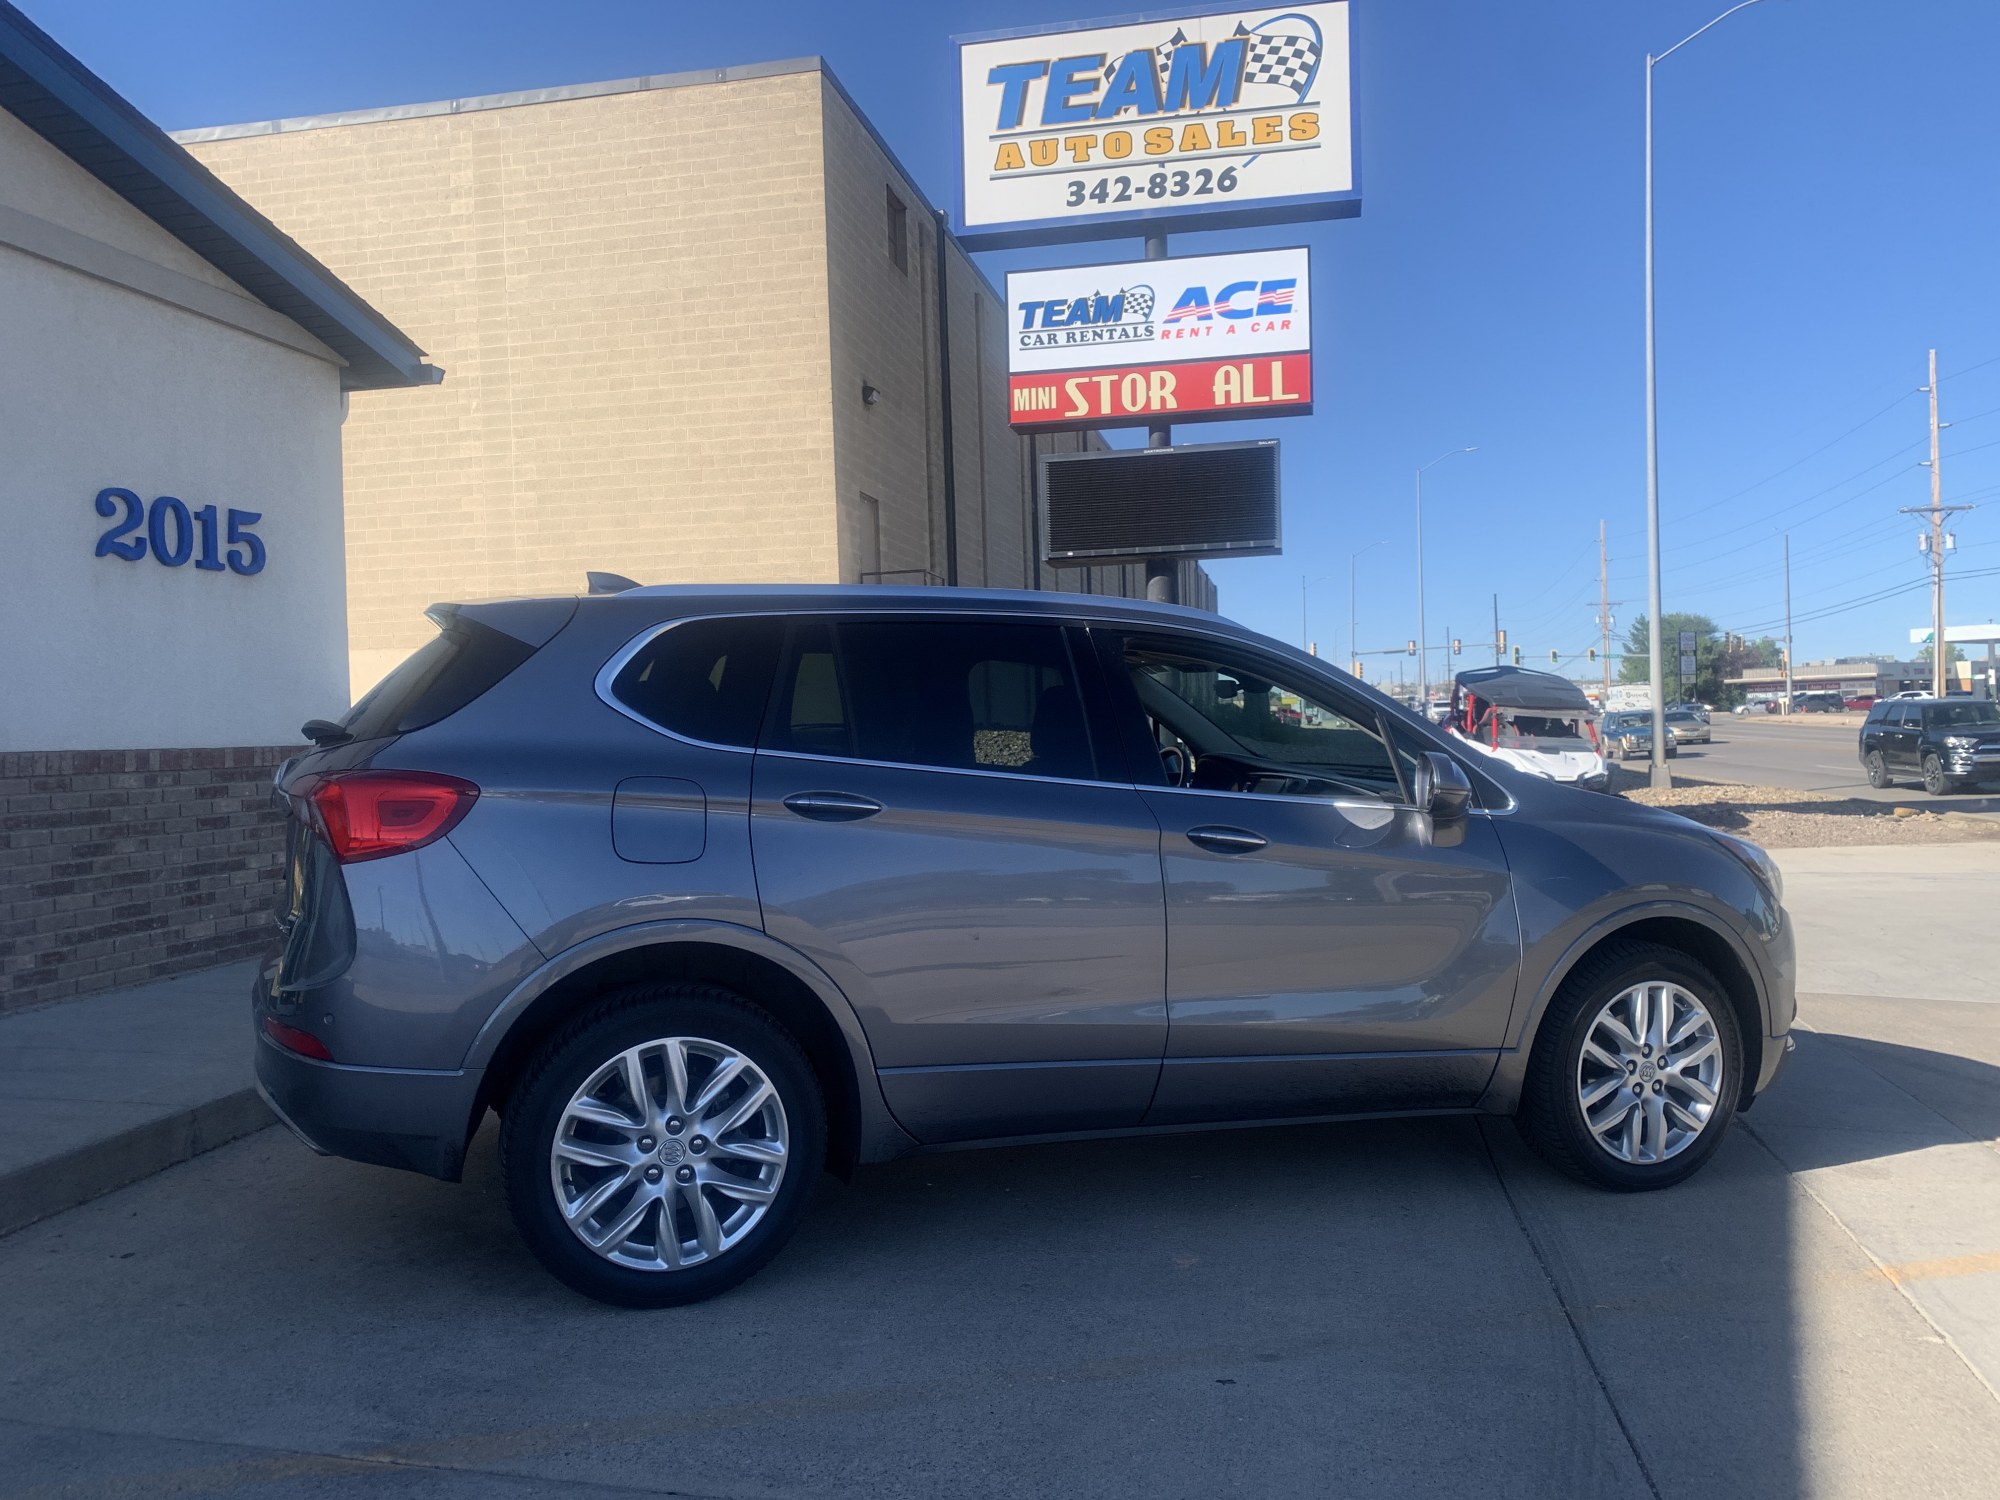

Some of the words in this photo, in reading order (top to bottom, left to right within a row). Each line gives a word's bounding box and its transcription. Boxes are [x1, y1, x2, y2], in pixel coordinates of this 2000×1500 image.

[986, 36, 1251, 131] TEAM
[994, 131, 1132, 170] AUTO
[1144, 112, 1320, 155] SALES
[1066, 166, 1238, 207] 342-8326
[1018, 294, 1126, 330] TEAM
[1162, 278, 1297, 324] ACE
[1020, 333, 1059, 346] CAR
[1066, 325, 1154, 344] RENTALS
[1161, 326, 1213, 340] RENT
[1226, 324, 1236, 335] A
[1250, 319, 1292, 333] CAR
[1013, 386, 1057, 412] MINI
[1064, 370, 1178, 417] STOR
[1212, 360, 1299, 405] ALL
[95, 487, 266, 576] 2015
